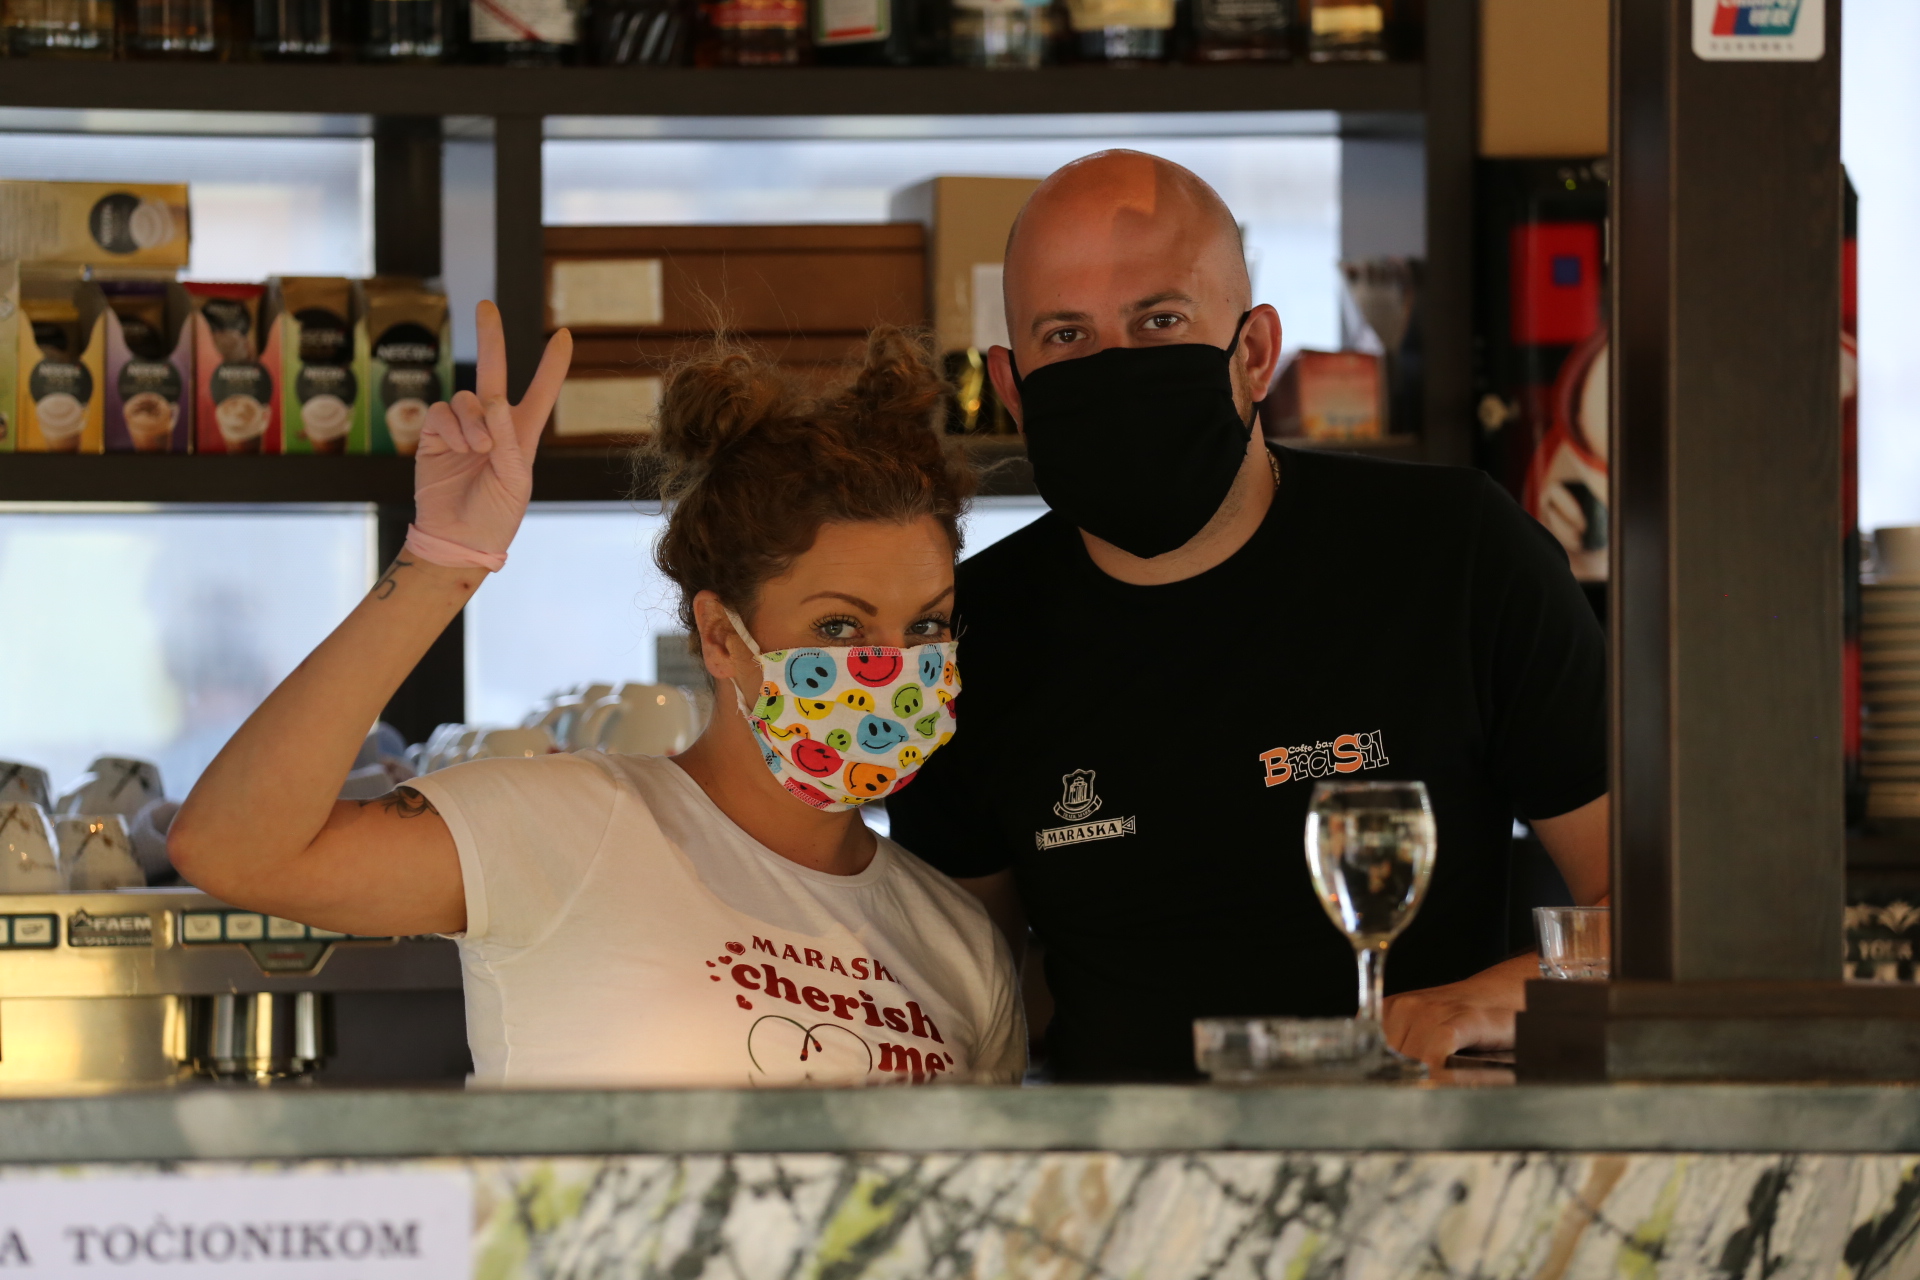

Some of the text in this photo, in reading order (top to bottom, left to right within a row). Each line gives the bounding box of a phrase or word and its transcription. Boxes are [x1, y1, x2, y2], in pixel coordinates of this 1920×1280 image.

[1315, 740, 1333, 750] bar
[1046, 822, 1118, 845] MARASKA
[752, 935, 904, 986] MARASK
[731, 963, 944, 1044] cherish
[64, 1213, 423, 1265] TOČIONIKOM
